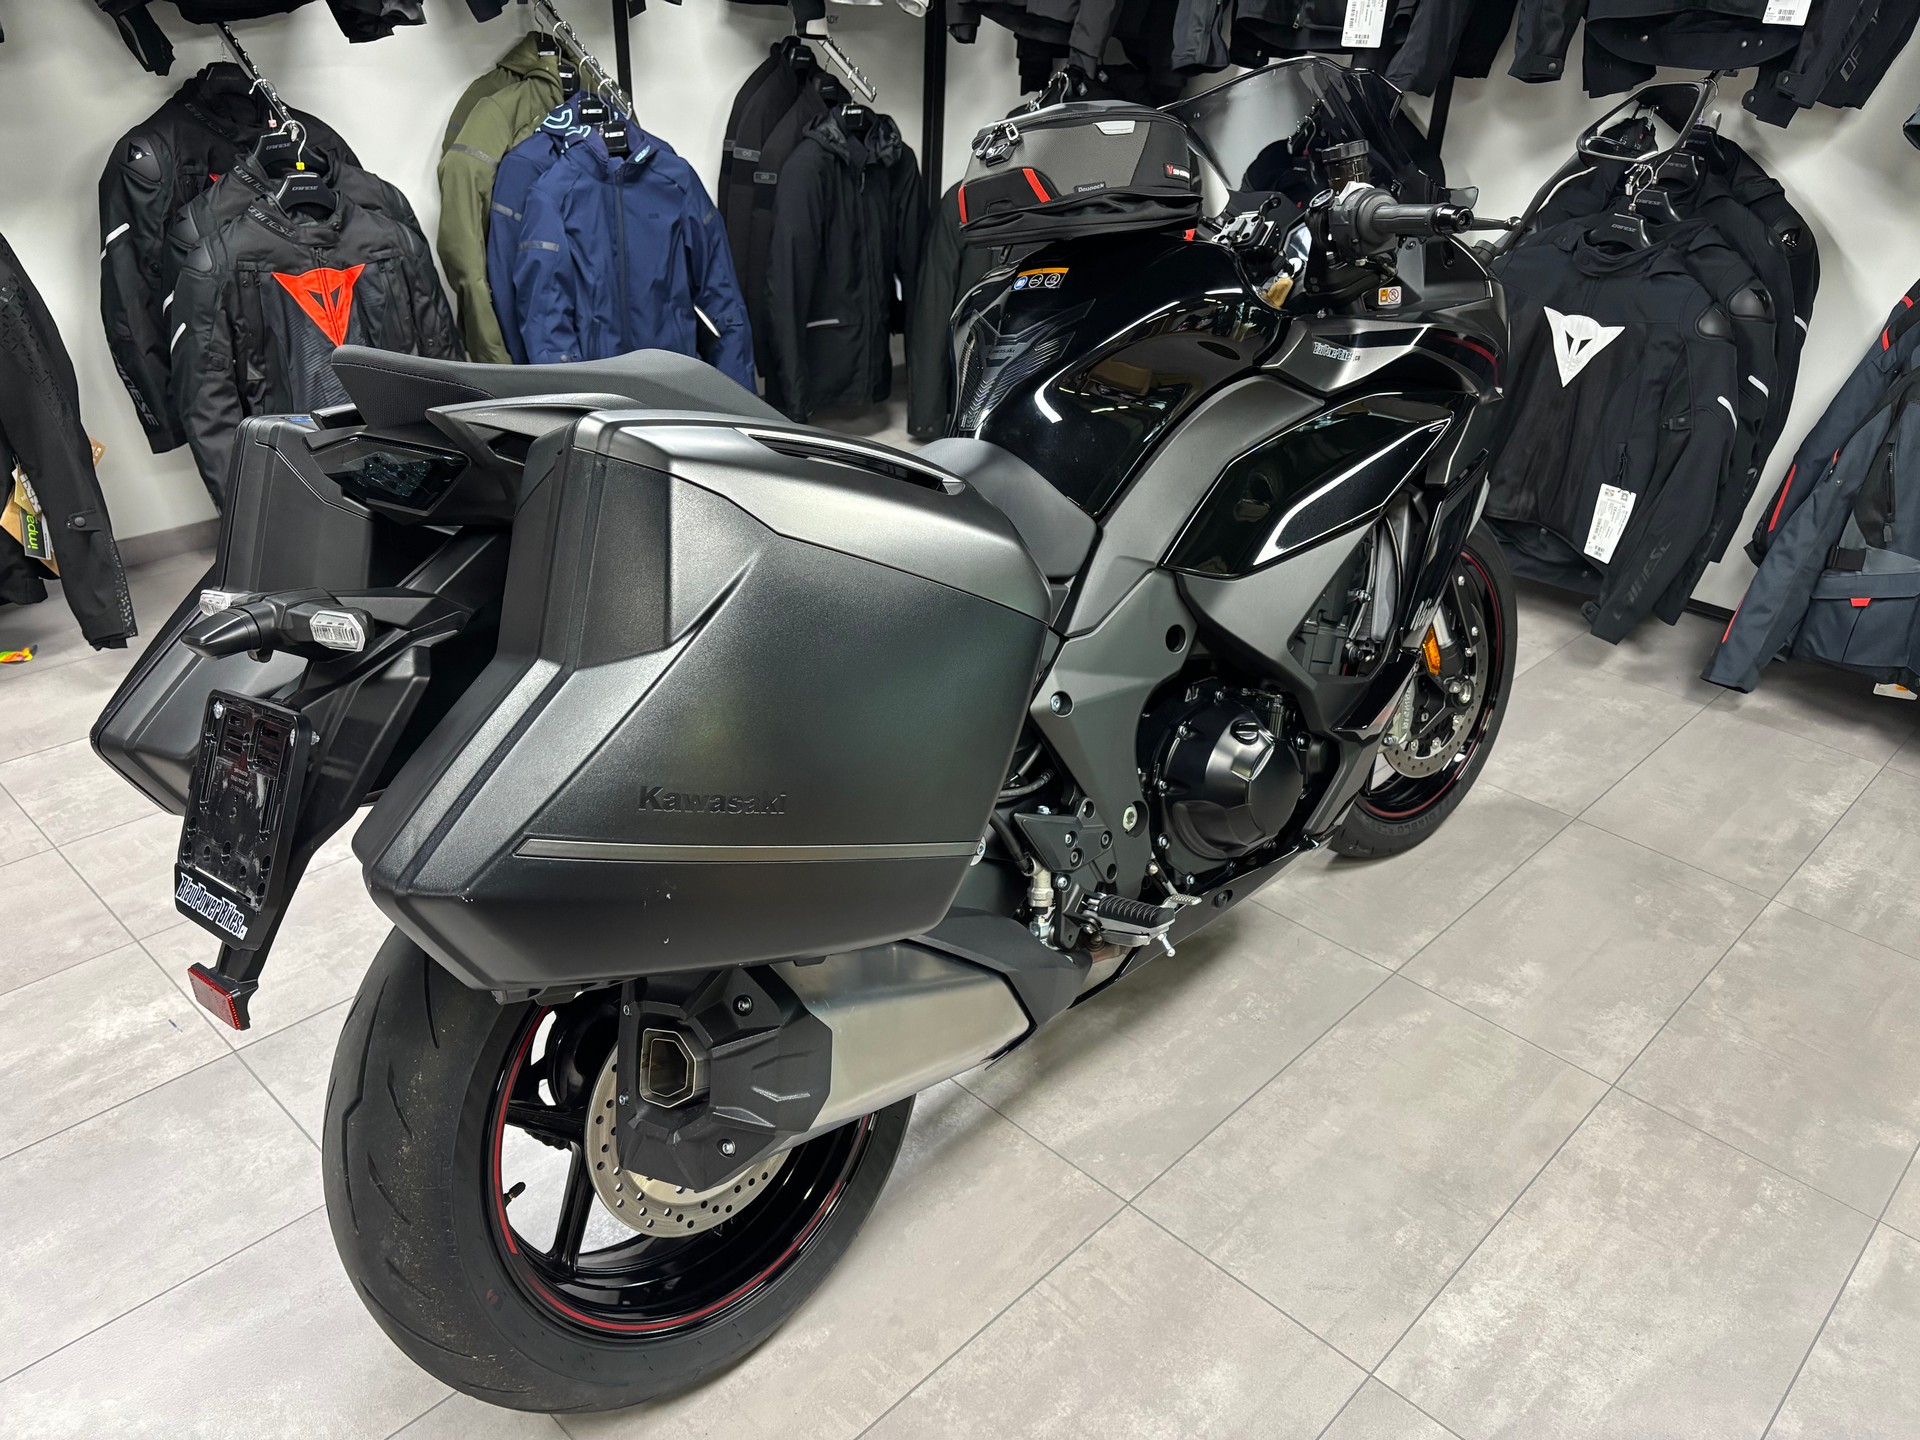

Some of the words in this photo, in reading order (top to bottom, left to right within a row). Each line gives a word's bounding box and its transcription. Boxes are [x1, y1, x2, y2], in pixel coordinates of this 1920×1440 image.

[247, 205, 296, 238] DAINESE
[1611, 223, 1638, 233] DAINESE
[26, 514, 39, 550] impa
[637, 785, 787, 815] Kawasaki
